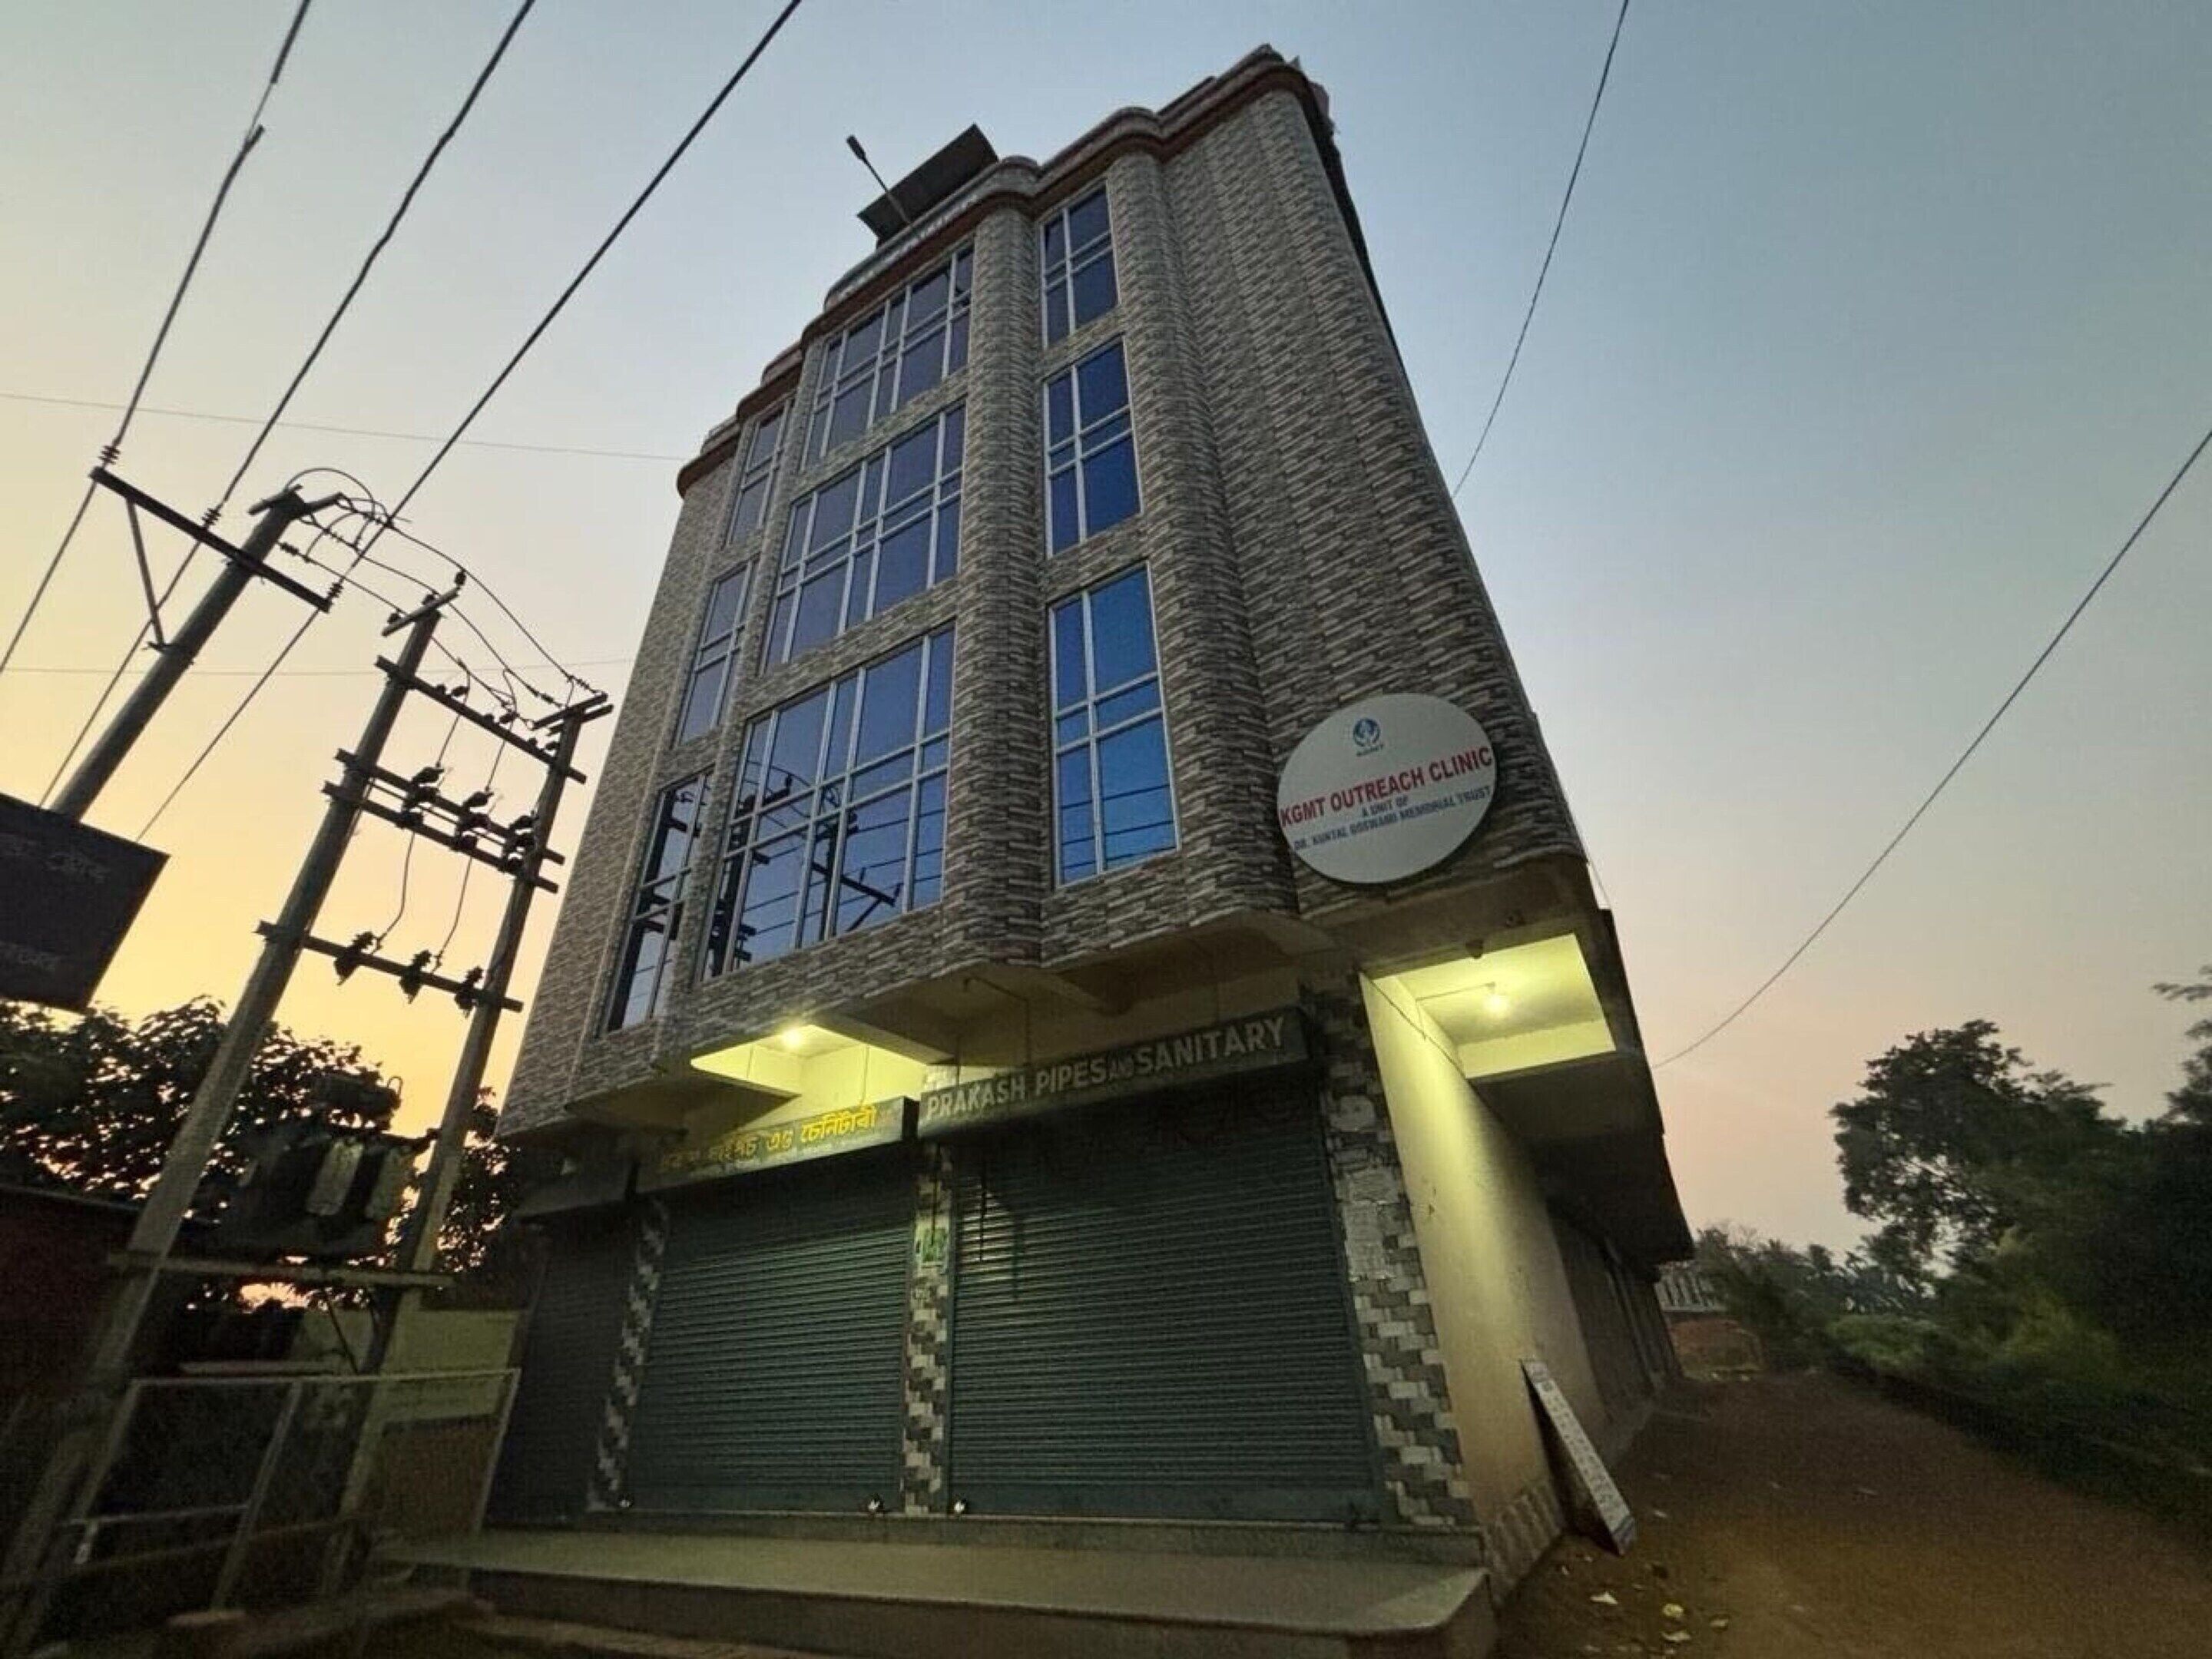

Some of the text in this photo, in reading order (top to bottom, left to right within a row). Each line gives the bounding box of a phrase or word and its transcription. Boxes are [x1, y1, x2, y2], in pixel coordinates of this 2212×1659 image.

[1280, 746, 1492, 827] KGMT OUTREACH CLINIC
[1456, 786, 1490, 806] TRUST
[926, 1074, 1026, 1120] PRAKASH
[1035, 1058, 1108, 1098] PIPES
[1136, 1016, 1284, 1073] SANITARY
